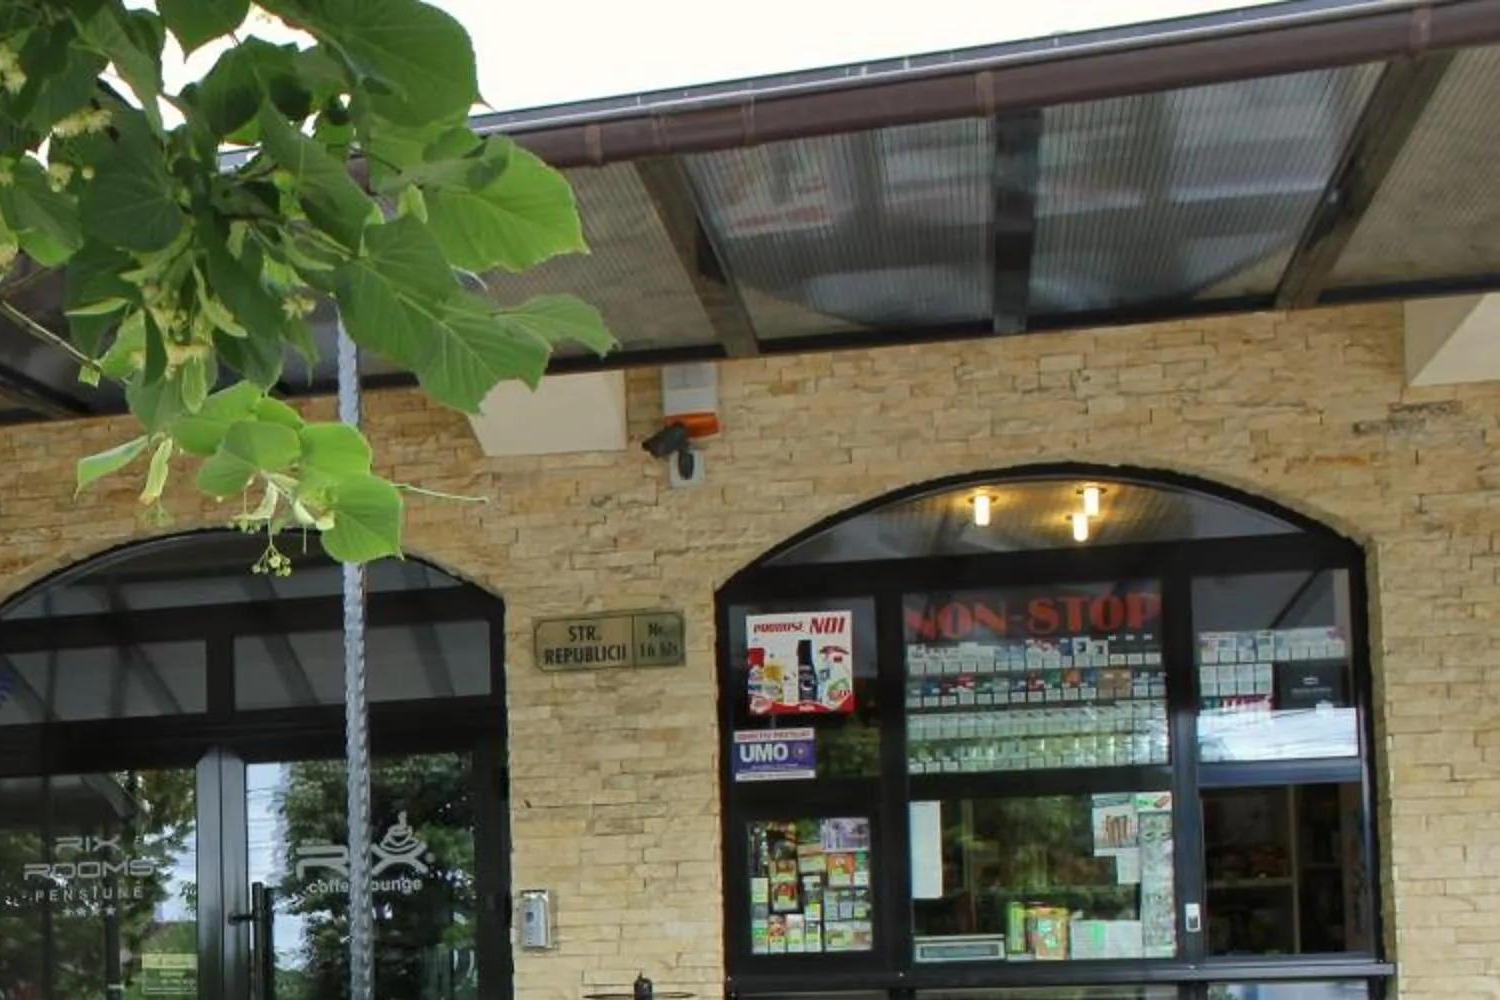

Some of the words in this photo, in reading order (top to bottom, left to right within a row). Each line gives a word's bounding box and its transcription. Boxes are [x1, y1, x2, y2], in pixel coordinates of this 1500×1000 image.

[568, 624, 602, 642] STR.
[544, 643, 627, 665] REPUBLICII
[739, 742, 789, 763] UMO
[55, 835, 121, 853] RIX
[23, 858, 154, 881] ROOMS
[296, 841, 428, 882] RX
[35, 885, 143, 902] PENSIUNE
[307, 878, 350, 893] coffe
[371, 877, 423, 895] ounge
